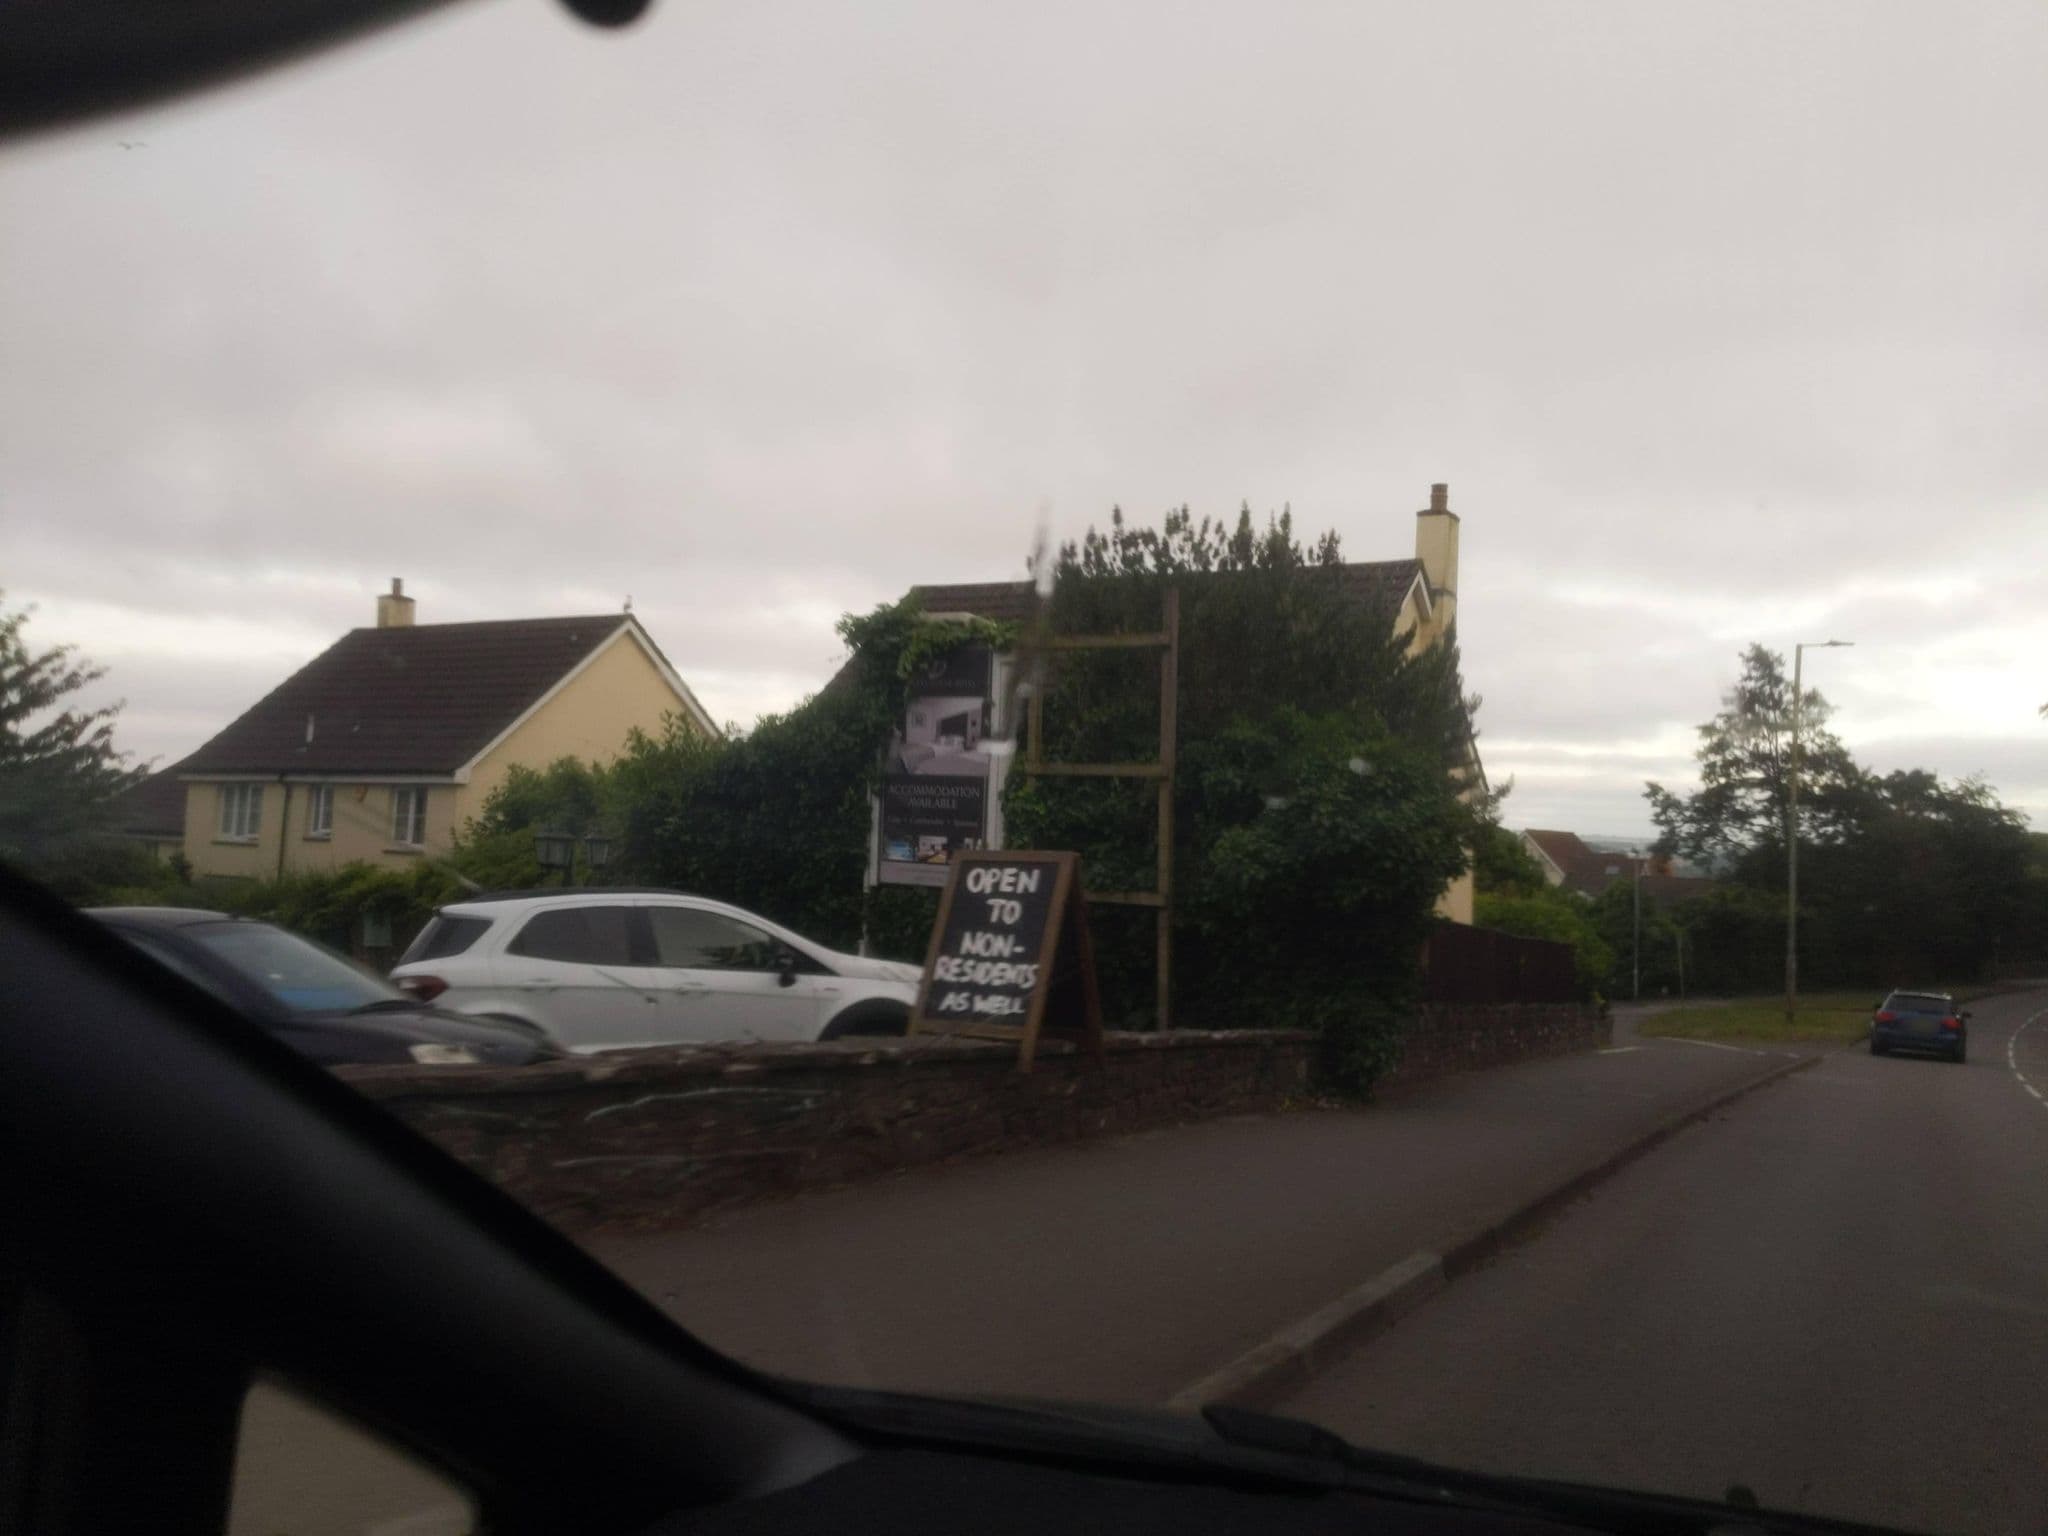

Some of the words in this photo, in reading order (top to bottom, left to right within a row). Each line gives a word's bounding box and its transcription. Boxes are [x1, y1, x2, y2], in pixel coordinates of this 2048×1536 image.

[888, 784, 980, 799] ACCOMMODATION
[909, 797, 957, 810] AVAILABLE
[967, 868, 1040, 894] OPEN
[986, 899, 1022, 924] TO
[960, 931, 1025, 957] NON-
[934, 956, 1039, 988] RESIDENTS
[938, 992, 970, 1011] AS
[973, 994, 1025, 1014] WELL
